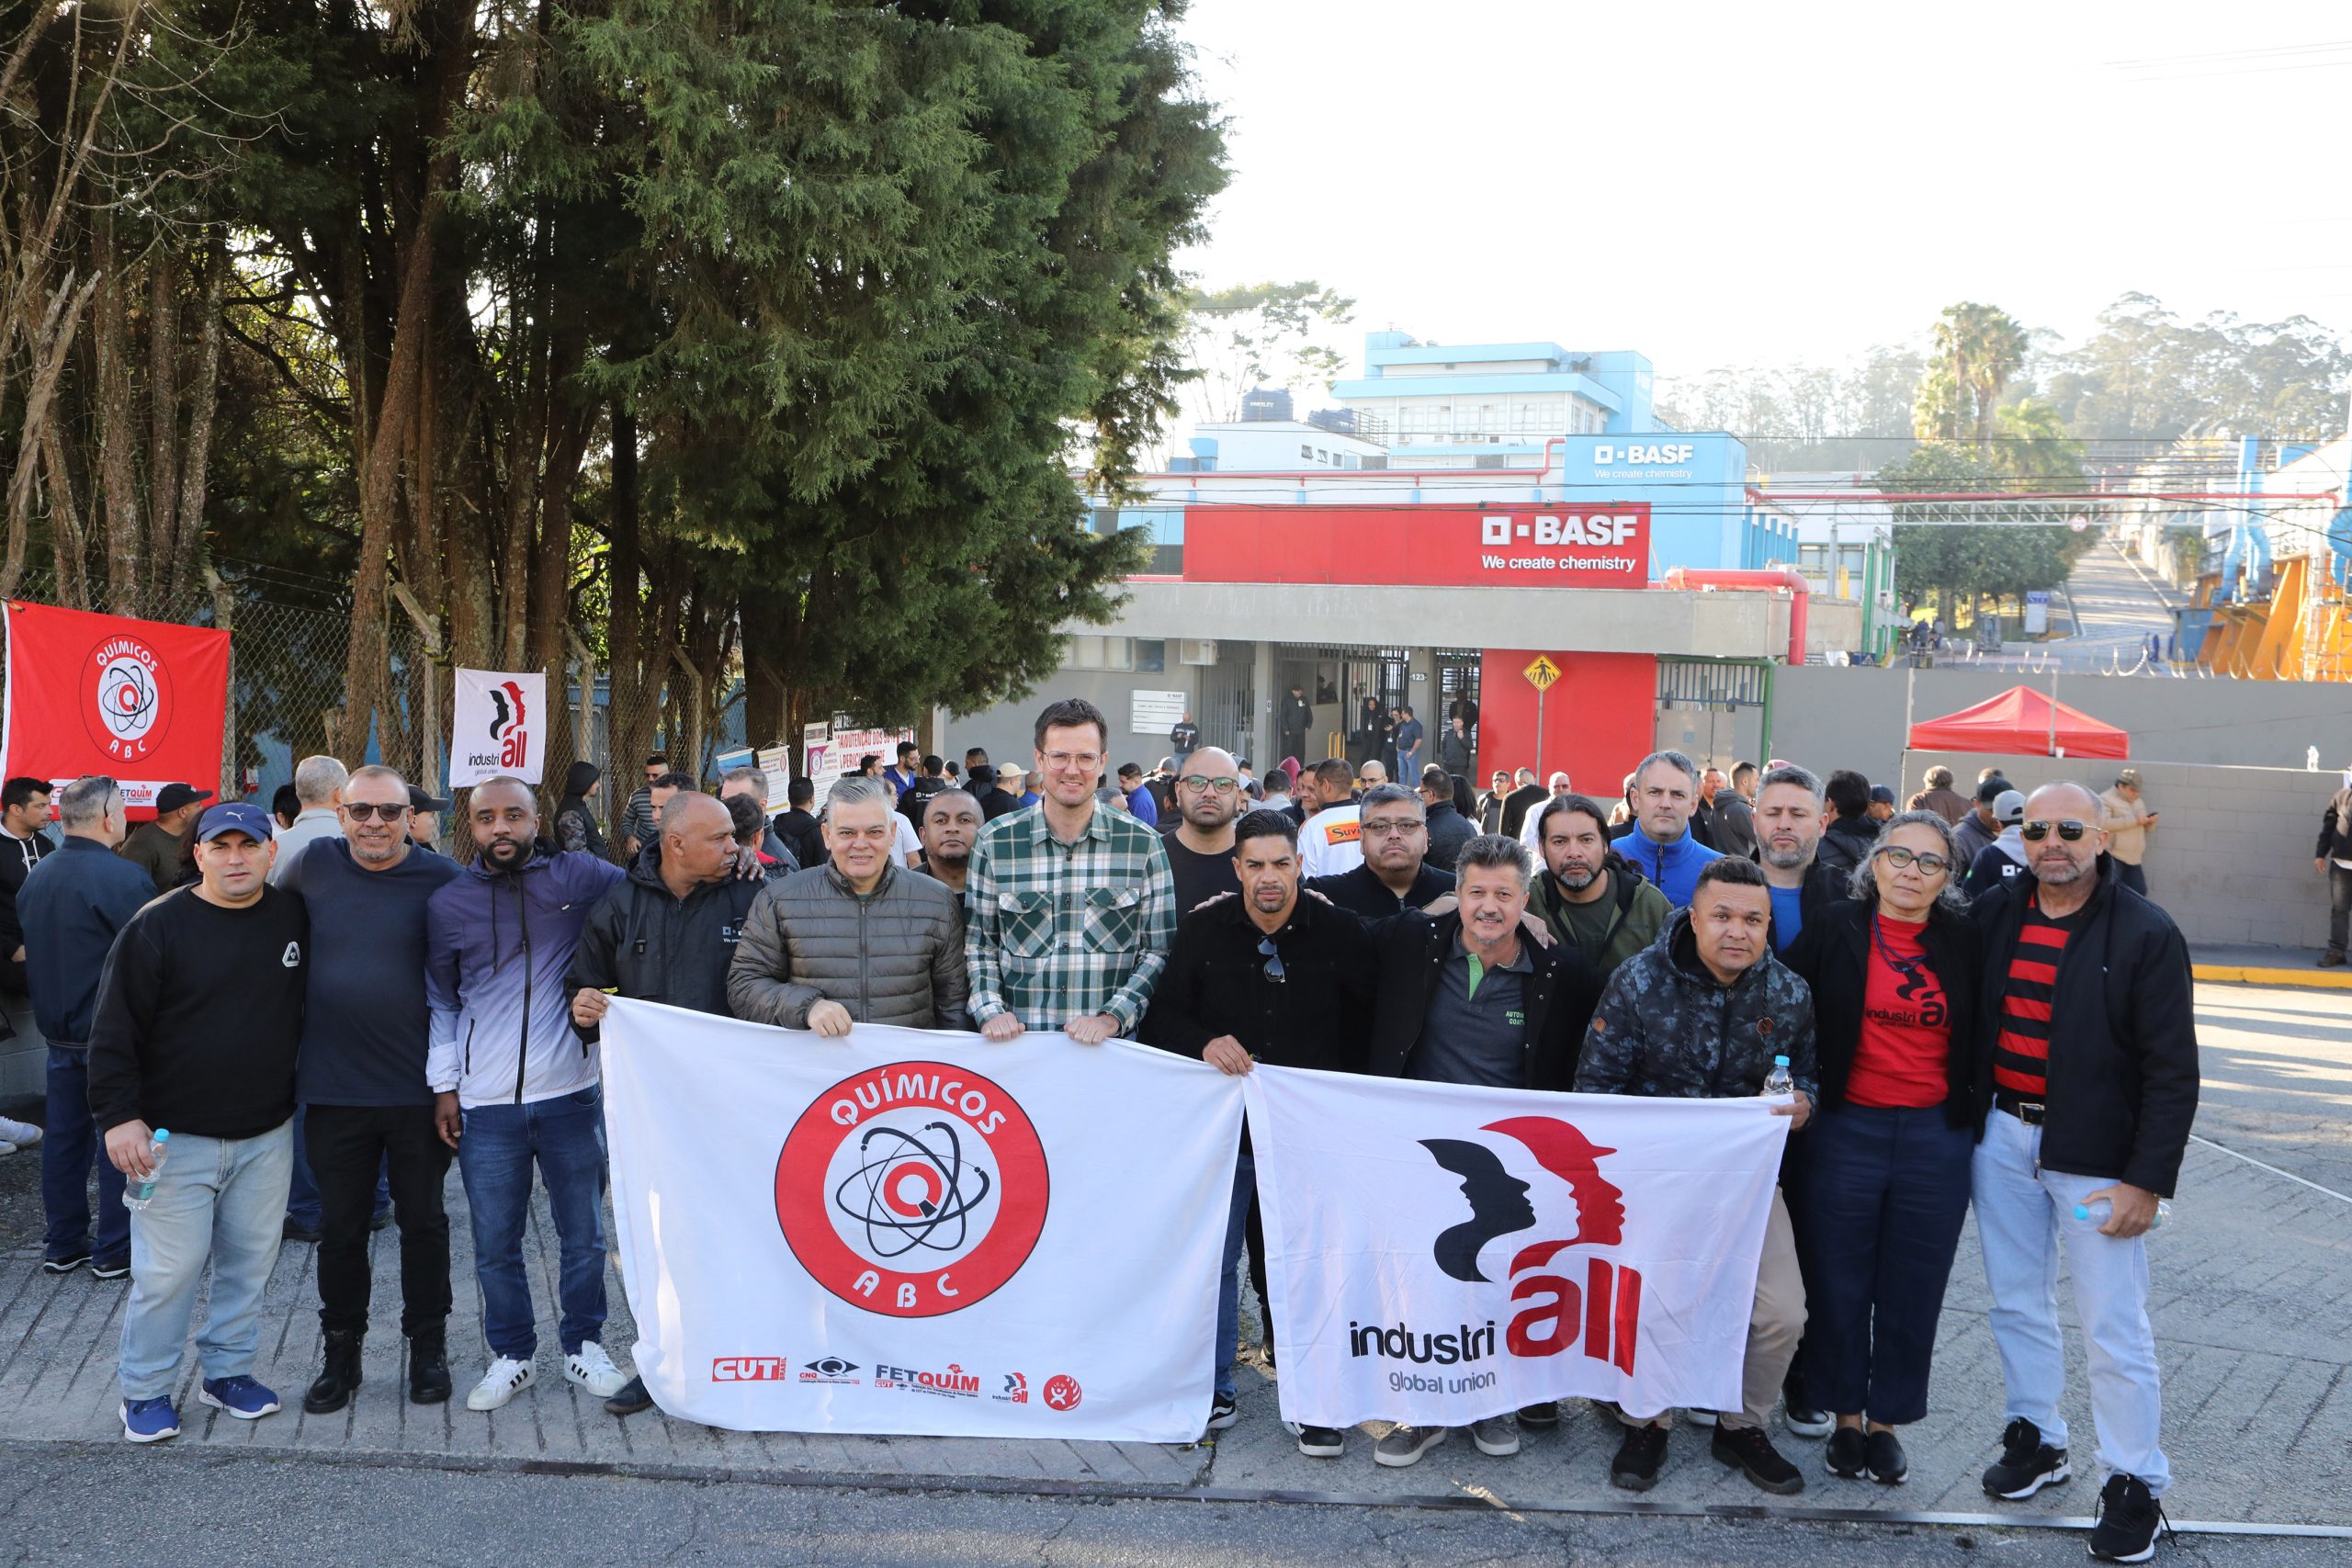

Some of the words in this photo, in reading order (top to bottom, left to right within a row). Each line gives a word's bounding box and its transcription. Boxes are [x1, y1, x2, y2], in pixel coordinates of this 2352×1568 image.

[1628, 445, 1694, 464] BASF
[1595, 469, 1611, 479] We
[1612, 469, 1643, 479] create
[1645, 469, 1692, 479] chemistry
[1535, 515, 1638, 546] BASF
[1482, 555, 1506, 569] We
[1509, 556, 1556, 570] create
[1559, 555, 1636, 572] chemistry
[96, 637, 158, 672] QUÍMICOS
[1332, 826, 1361, 838] Suvi
[831, 1070, 1007, 1134] QUÍMICOS
[714, 1359, 778, 1380] CUT
[779, 1357, 787, 1381] BRASIL
[876, 1364, 980, 1392] FETQUIM
[1389, 1371, 1443, 1393] global
[1449, 1371, 1496, 1393] union
